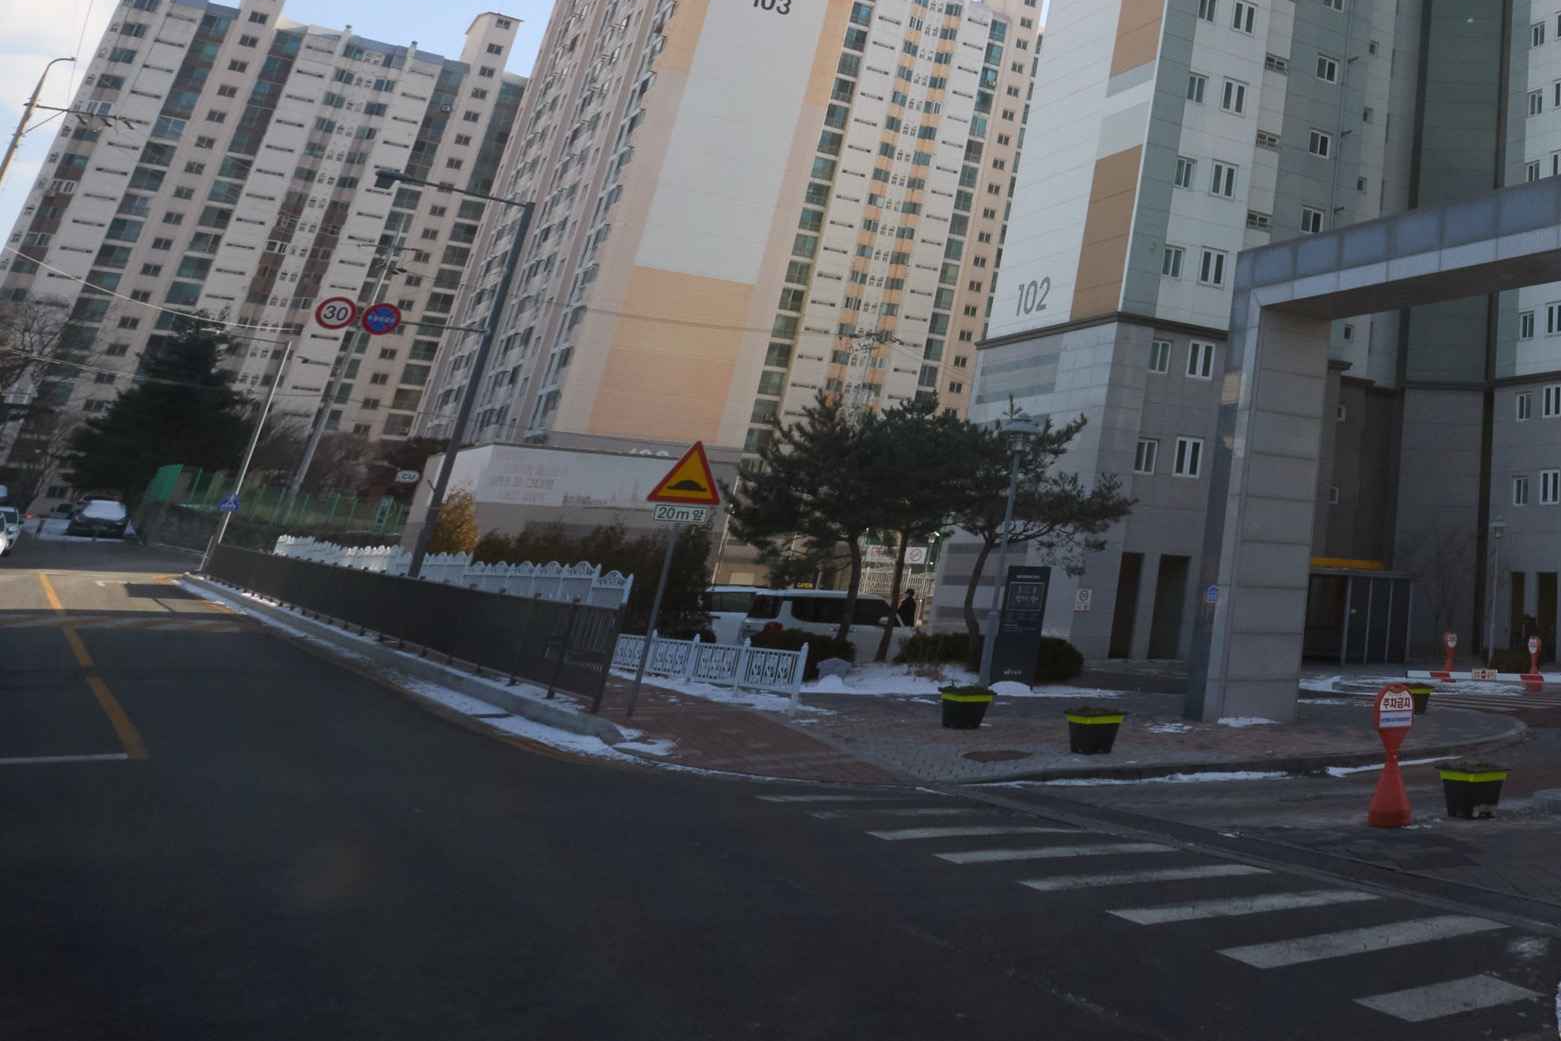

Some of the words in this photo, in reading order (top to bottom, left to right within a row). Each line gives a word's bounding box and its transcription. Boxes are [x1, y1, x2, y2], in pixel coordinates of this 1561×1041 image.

[1016, 276, 1050, 316] 102
[323, 305, 348, 321] 30
[657, 507, 689, 520] 20m
[1383, 696, 1411, 710] 주차금지
